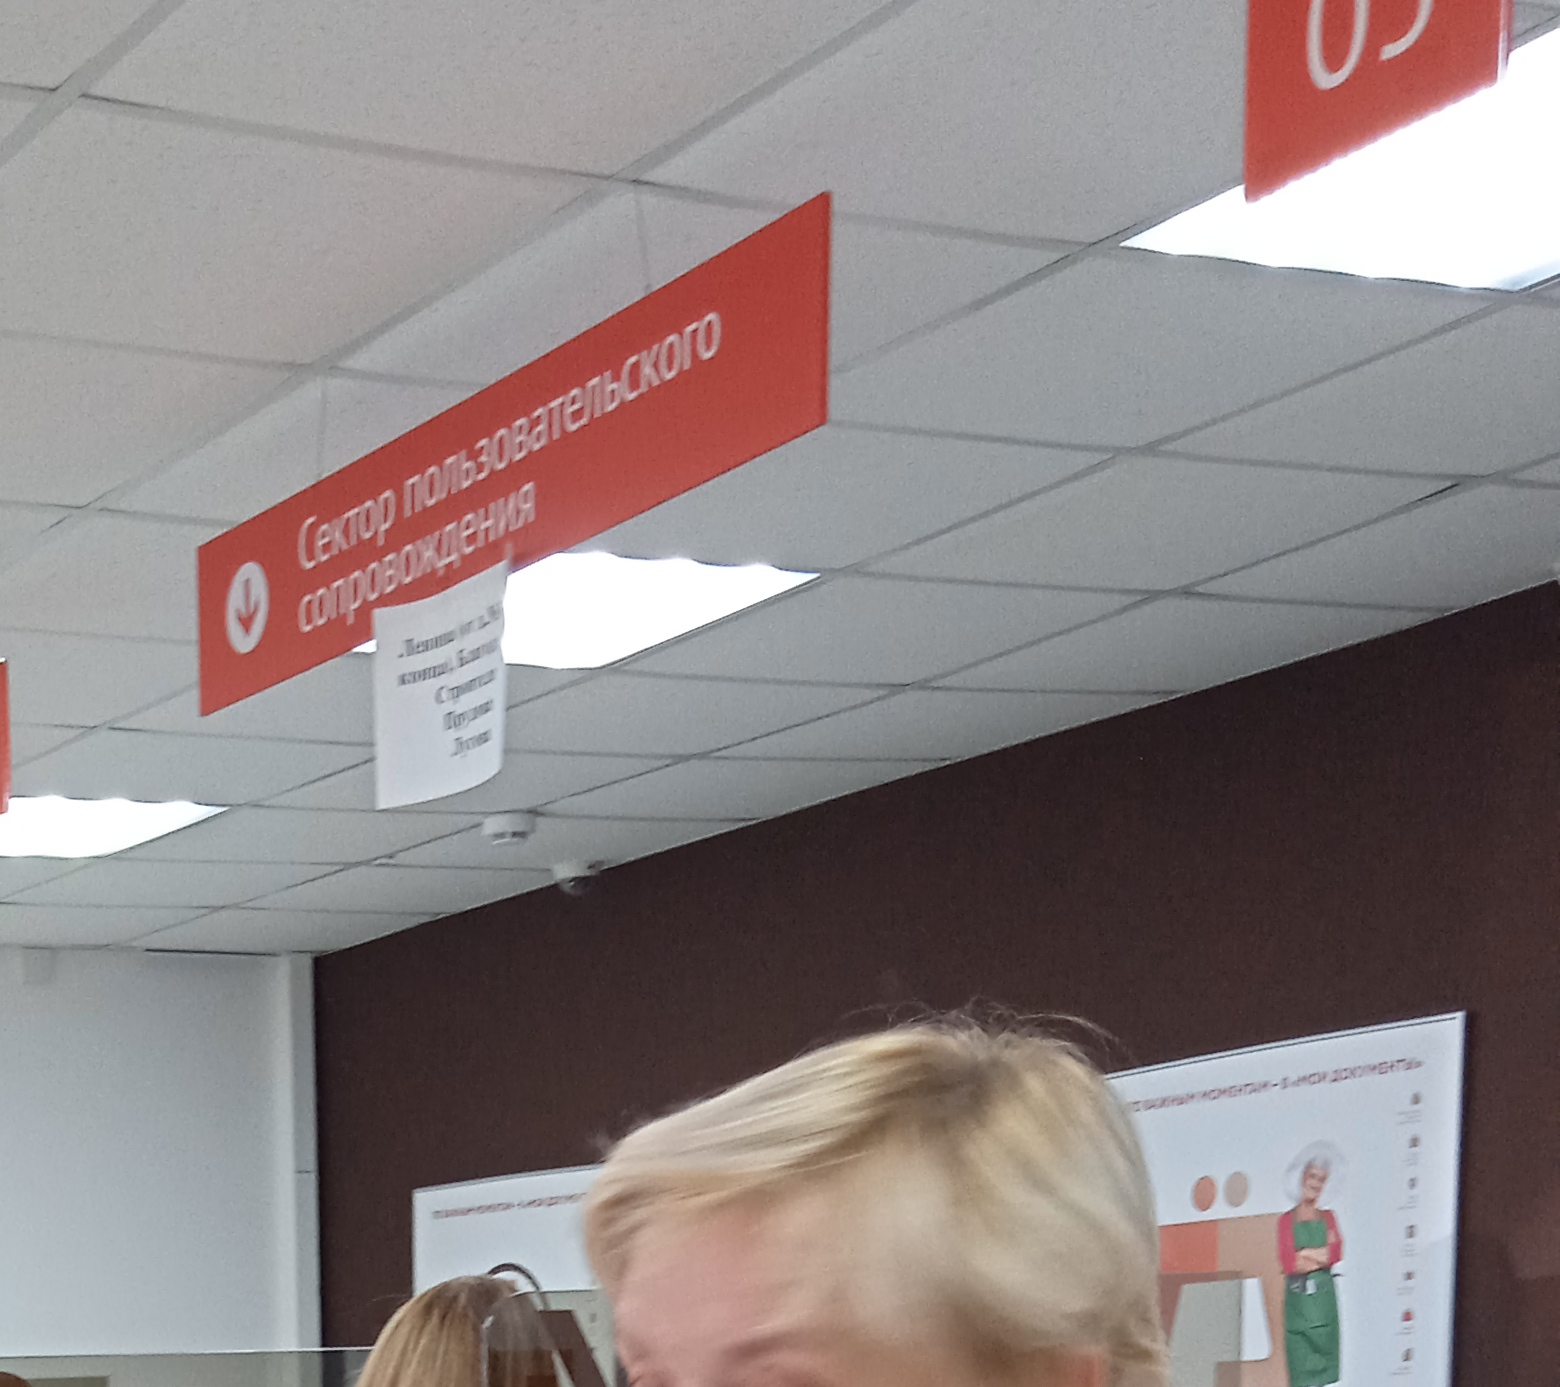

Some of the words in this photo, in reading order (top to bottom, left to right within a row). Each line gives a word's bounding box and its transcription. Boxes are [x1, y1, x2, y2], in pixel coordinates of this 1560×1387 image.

[297, 490, 396, 571] Сектор
[404, 312, 722, 518] пользовательского
[298, 481, 536, 634] сопровождения
